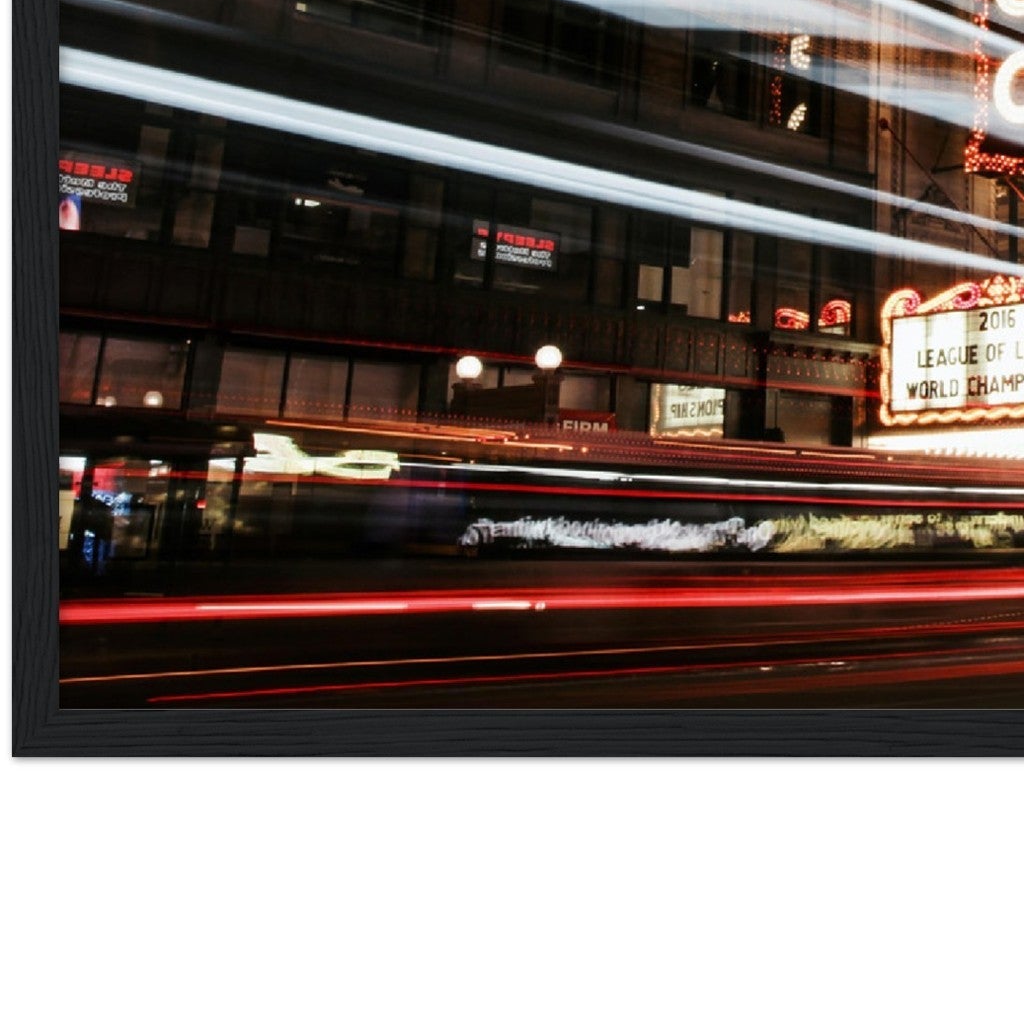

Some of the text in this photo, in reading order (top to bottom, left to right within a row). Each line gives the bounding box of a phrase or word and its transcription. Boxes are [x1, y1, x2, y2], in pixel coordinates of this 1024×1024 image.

[979, 309, 1016, 331] 2016
[917, 344, 979, 368] LEAGUE
[986, 343, 1006, 363] OF
[906, 378, 960, 400] WORLD
